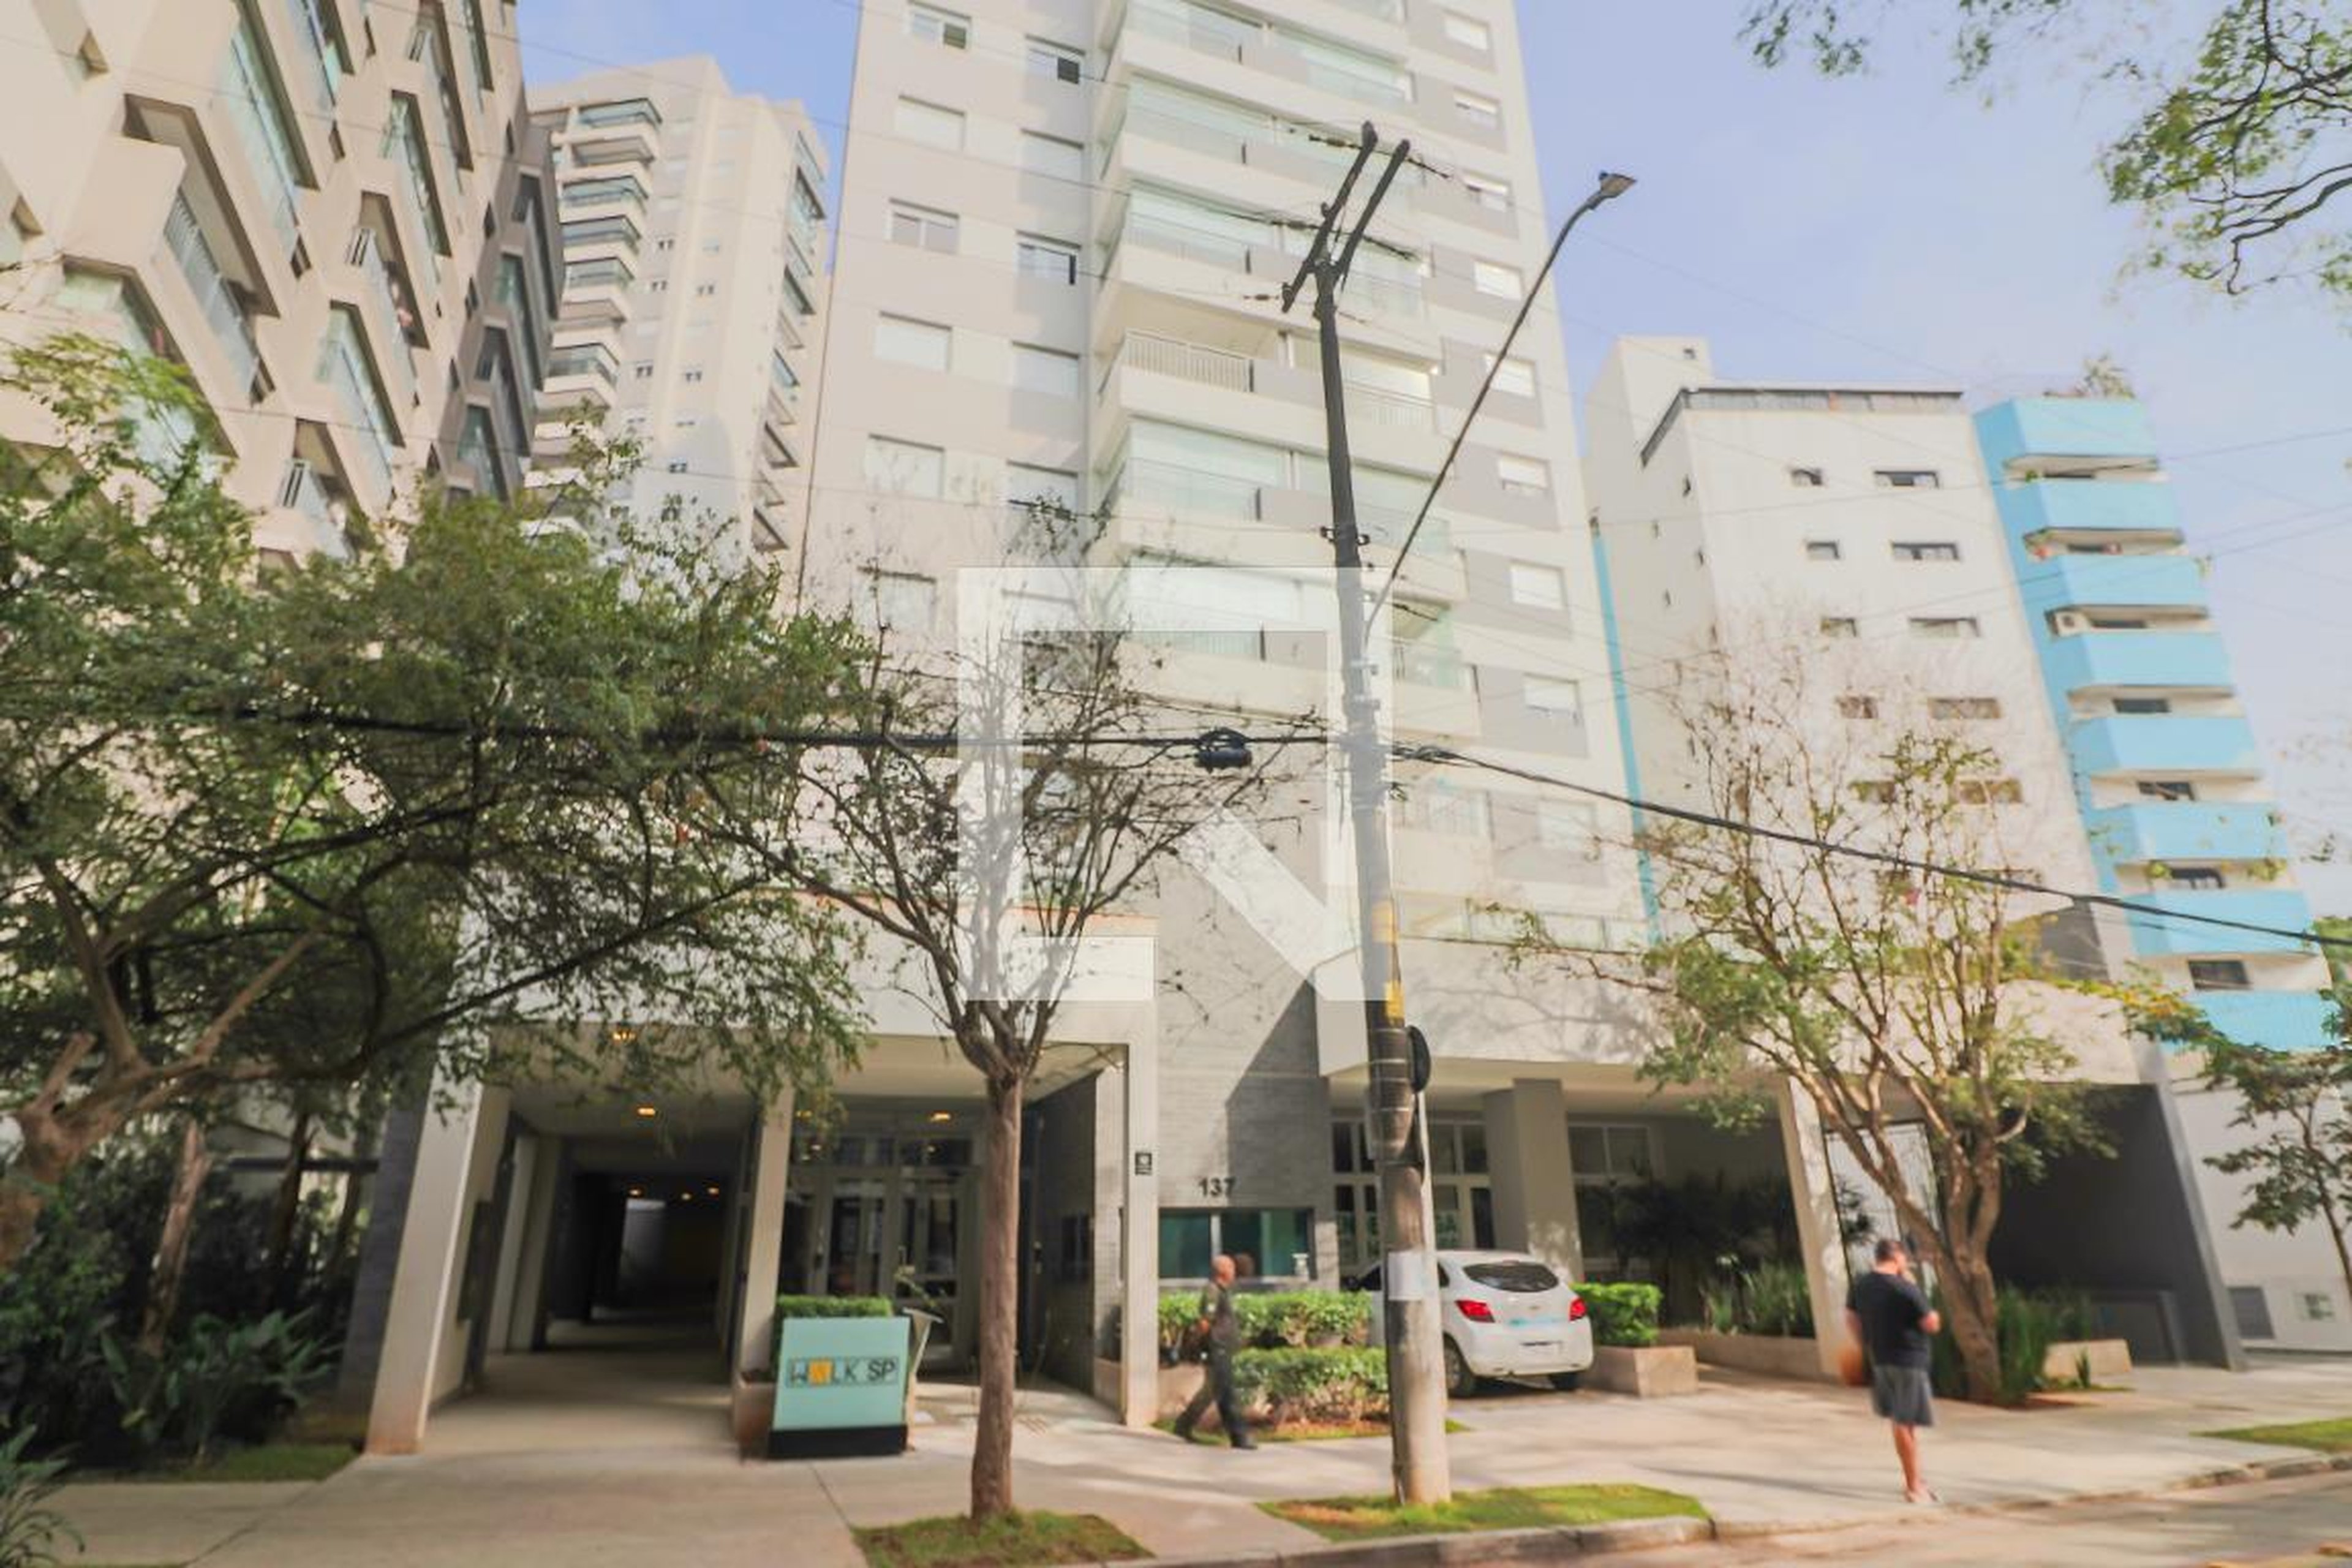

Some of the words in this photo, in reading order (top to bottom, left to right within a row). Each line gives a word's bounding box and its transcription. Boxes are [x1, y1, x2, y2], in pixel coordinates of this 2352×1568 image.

[1198, 1176, 1236, 1197] 137
[790, 1358, 858, 1384] WLK
[867, 1358, 895, 1381] SP
